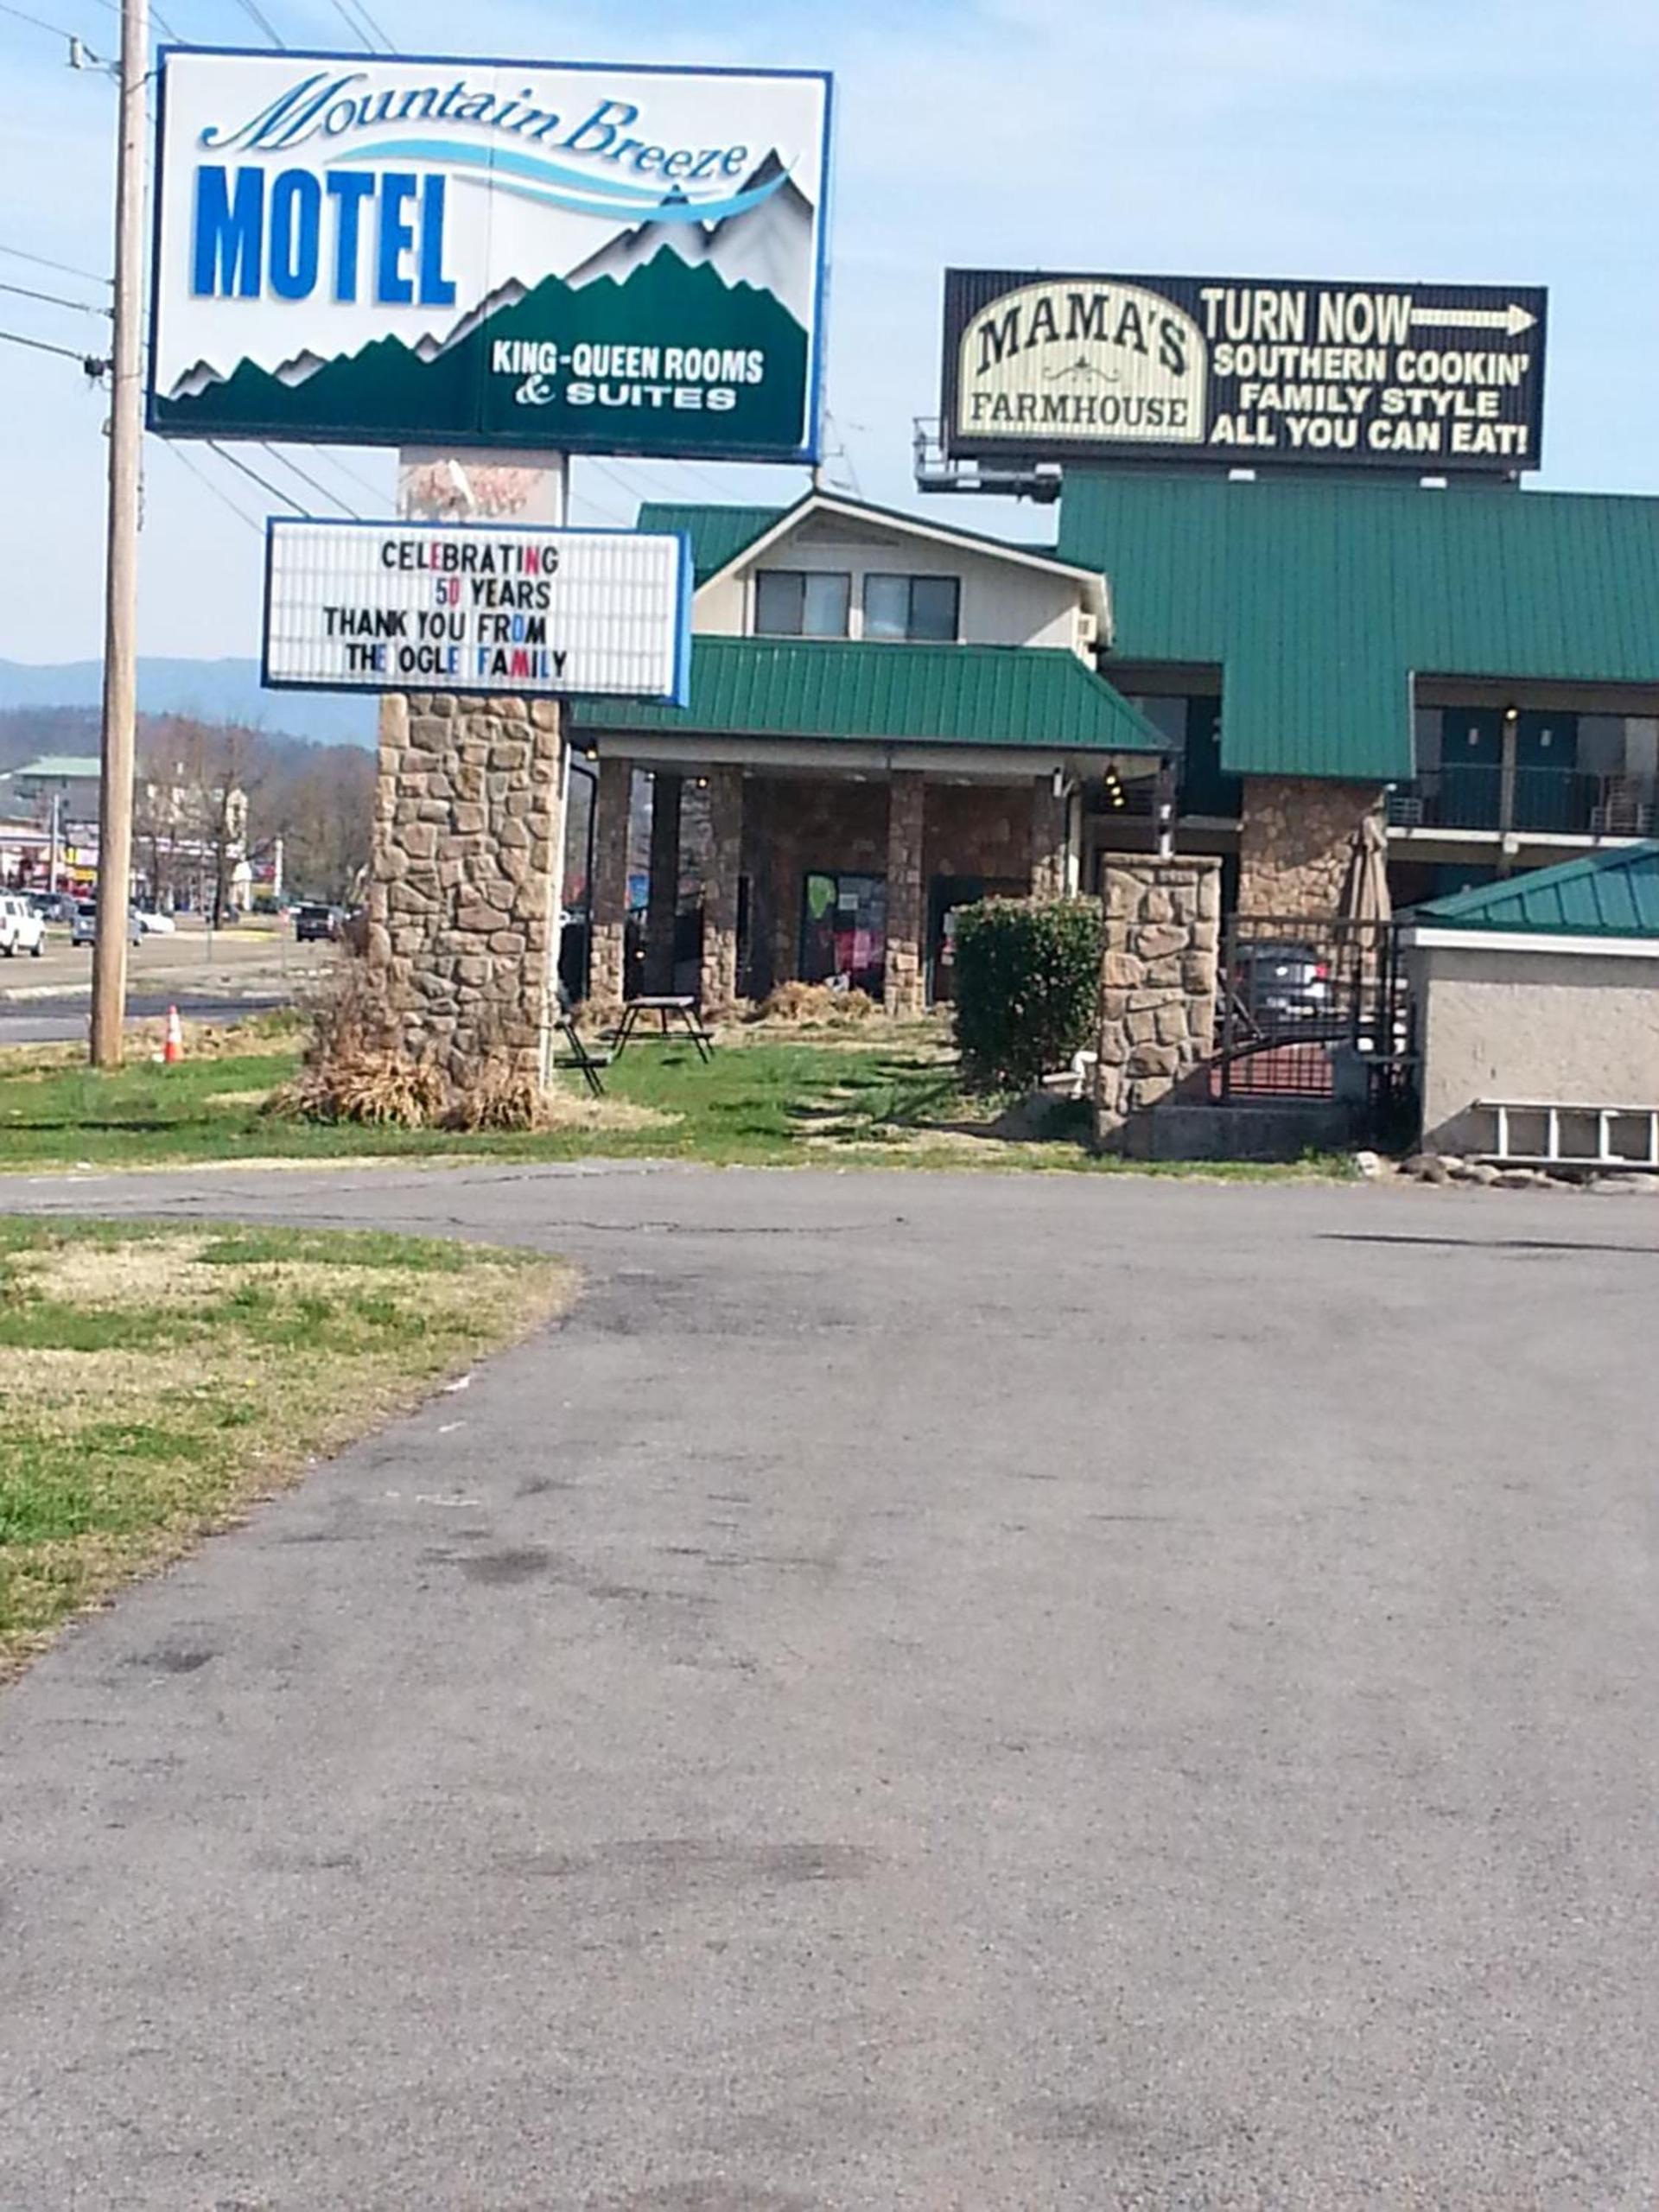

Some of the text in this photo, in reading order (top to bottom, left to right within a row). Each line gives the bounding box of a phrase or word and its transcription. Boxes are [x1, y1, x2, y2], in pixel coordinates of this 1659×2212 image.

[199, 72, 749, 178] Mountain Breeze
[194, 166, 457, 305] MOTEL
[976, 293, 1187, 377] MAMA'S
[1201, 288, 1412, 345] TURN NOW
[664, 347, 765, 384] ROOMS
[1213, 345, 1529, 386] SOUTHERN COOKIN'
[515, 373, 738, 412] & SUITES
[971, 392, 1188, 427] FARMHOUSE
[1239, 383, 1499, 418] FAMILY STYLE
[1211, 415, 1529, 454] ALL YOU CAN EAT!
[382, 541, 559, 574] CELEBRATING
[436, 578, 551, 607] 50 YEARS
[324, 607, 547, 644] THANK YOU FROM
[346, 644, 568, 678] THE OGLE FAMILY
